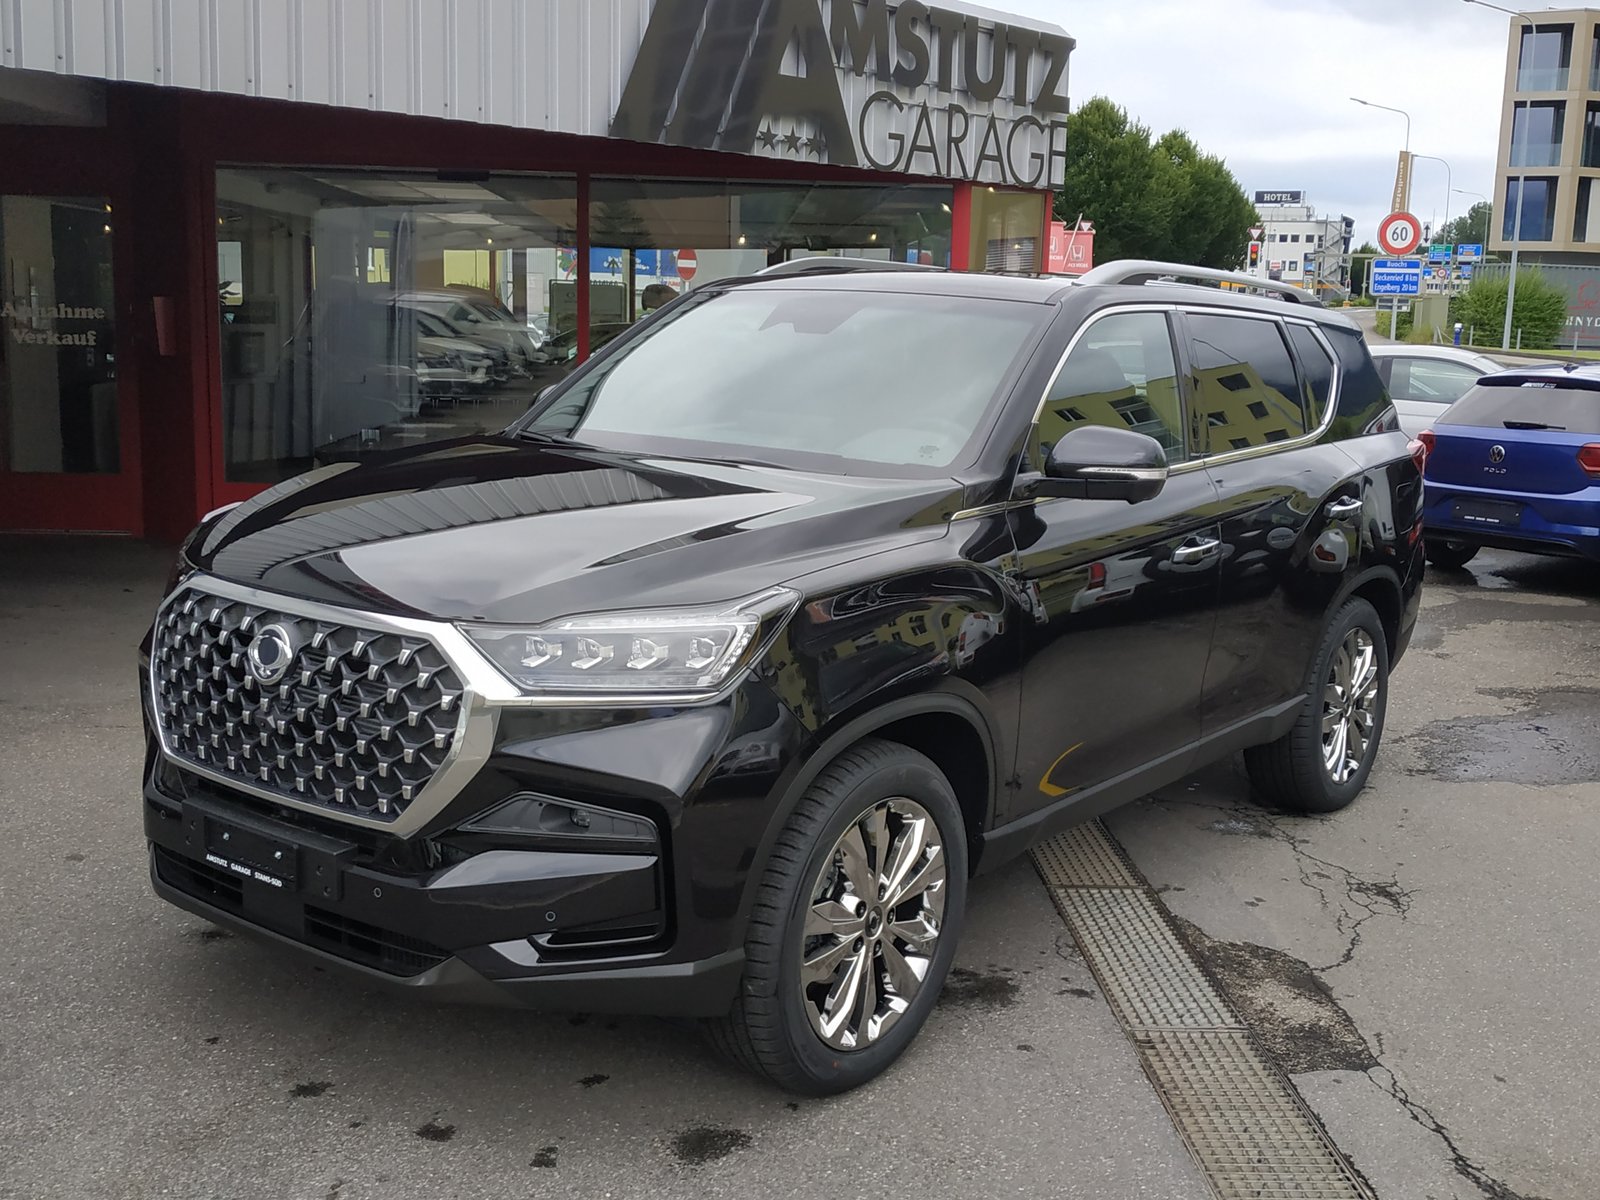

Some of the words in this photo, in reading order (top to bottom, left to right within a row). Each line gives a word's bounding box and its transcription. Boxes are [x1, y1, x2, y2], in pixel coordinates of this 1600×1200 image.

[859, 91, 1067, 191] GARAGE
[1263, 193, 1293, 201] HOTEL
[1391, 226, 1408, 242] 60
[1375, 273, 1404, 282] Beckenried
[1374, 283, 1400, 292] Engelberg
[1401, 283, 1409, 291] 20
[1409, 283, 1417, 291] km
[10, 329, 97, 346] Verkauf
[1483, 466, 1507, 474] POLO
[206, 854, 228, 867] AMSTUTZ
[231, 863, 252, 875] GARAGE
